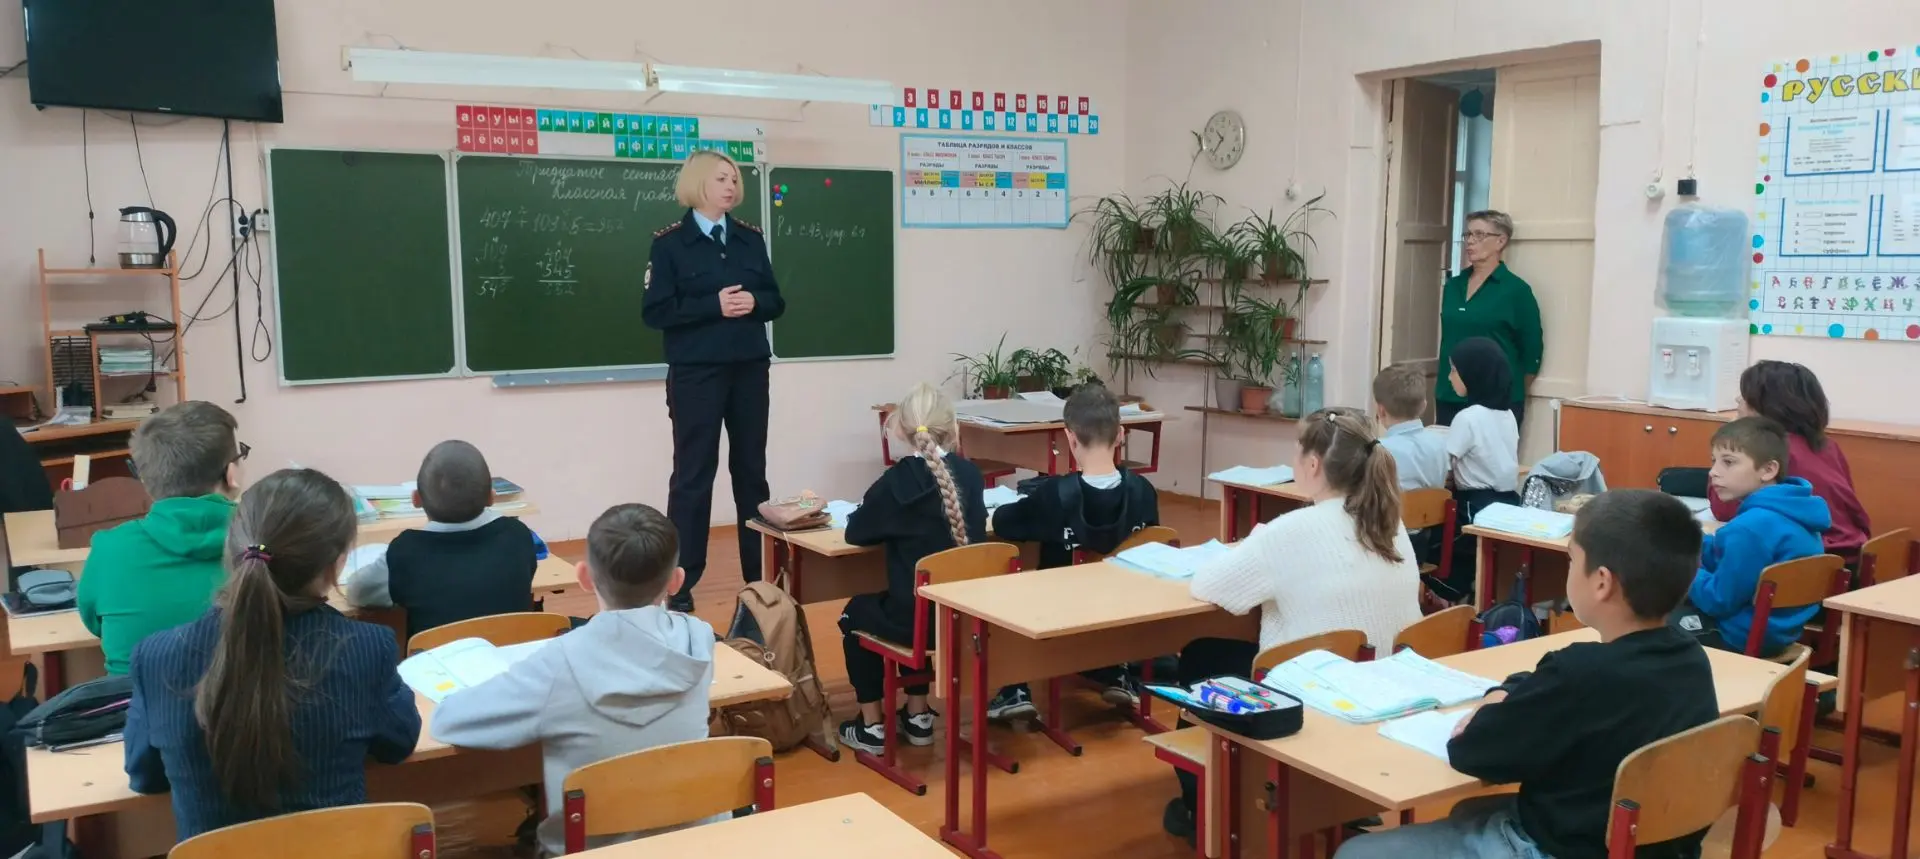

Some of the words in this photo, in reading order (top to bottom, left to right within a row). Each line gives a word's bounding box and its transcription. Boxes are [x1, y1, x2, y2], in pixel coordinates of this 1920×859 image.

[907, 93, 913, 103] 3
[930, 94, 936, 104] 5
[996, 98, 1003, 107] 11
[1018, 99, 1025, 108] 13
[1039, 100, 1046, 109] 15
[1060, 101, 1067, 110] 17
[1080, 102, 1087, 110] 19
[461, 113, 469, 122] а
[477, 113, 485, 122] о
[493, 113, 501, 124] у
[508, 115, 519, 123] ы
[526, 115, 533, 125] э
[541, 117, 550, 126] л
[555, 117, 566, 126] м
[572, 118, 579, 127] н
[587, 118, 595, 129] р
[603, 116, 611, 129] й
[617, 118, 625, 129] б
[631, 121, 639, 130] в
[647, 121, 653, 130] г
[659, 121, 669, 132] д
[674, 123, 684, 132] ж
[896, 112, 902, 121] 2
[919, 113, 925, 122] 4
[942, 113, 948, 123] 6
[965, 115, 970, 124] 8
[985, 116, 993, 125] 10
[1007, 117, 1014, 126] 12
[1028, 118, 1035, 127] 14
[1049, 119, 1056, 128] 16
[1070, 119, 1077, 128] 18
[1090, 120, 1097, 129] 20
[462, 135, 471, 144] я
[478, 134, 486, 144] ё
[493, 136, 504, 145] ю
[510, 137, 519, 146] и
[527, 137, 535, 146] е
[618, 142, 625, 151] п
[632, 140, 641, 152] ф
[647, 142, 654, 151] к
[661, 143, 669, 152] т
[674, 144, 684, 152] ш
[743, 147, 752, 157] щ
[968, 142, 1000, 150] РАЗРЯДОВ
[1887, 276, 1908, 289] Ж
